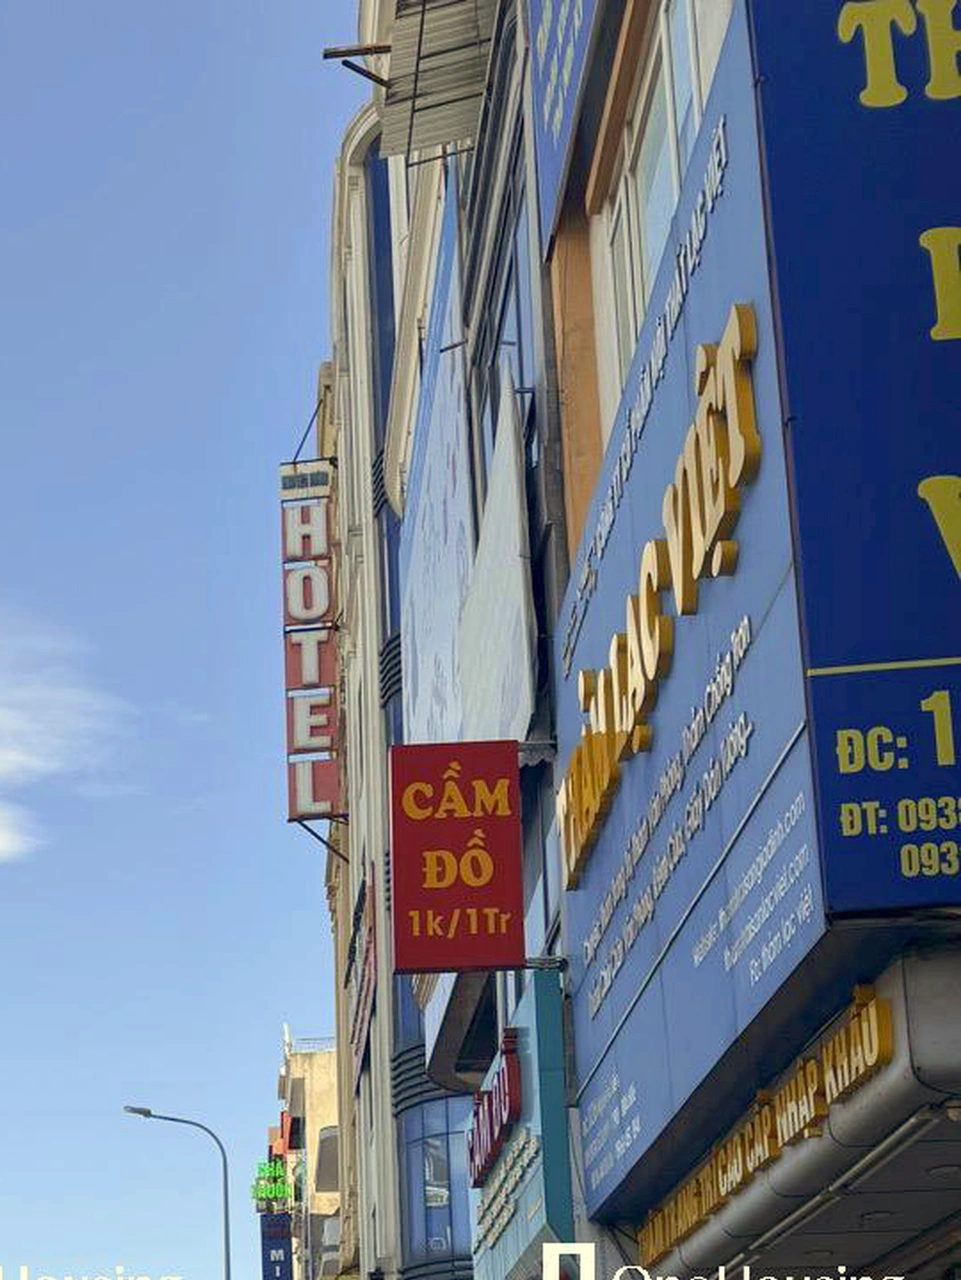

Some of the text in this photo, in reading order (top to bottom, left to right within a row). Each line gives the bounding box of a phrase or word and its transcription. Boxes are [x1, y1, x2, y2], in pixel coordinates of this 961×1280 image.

[662, 305, 744, 616] VIỆT
[286, 501, 332, 813] HOTEL
[836, 726, 908, 774] ĐC:
[401, 760, 513, 819] CẦM
[840, 796, 961, 837] ĐT: 093
[422, 828, 494, 889] ĐỒ
[900, 841, 961, 878] 093
[408, 908, 512, 939] 1k/1Tr
[718, 1134, 743, 1196] CAO
[775, 1057, 818, 1149] NHẬP
[822, 990, 879, 1104] KHẨU
